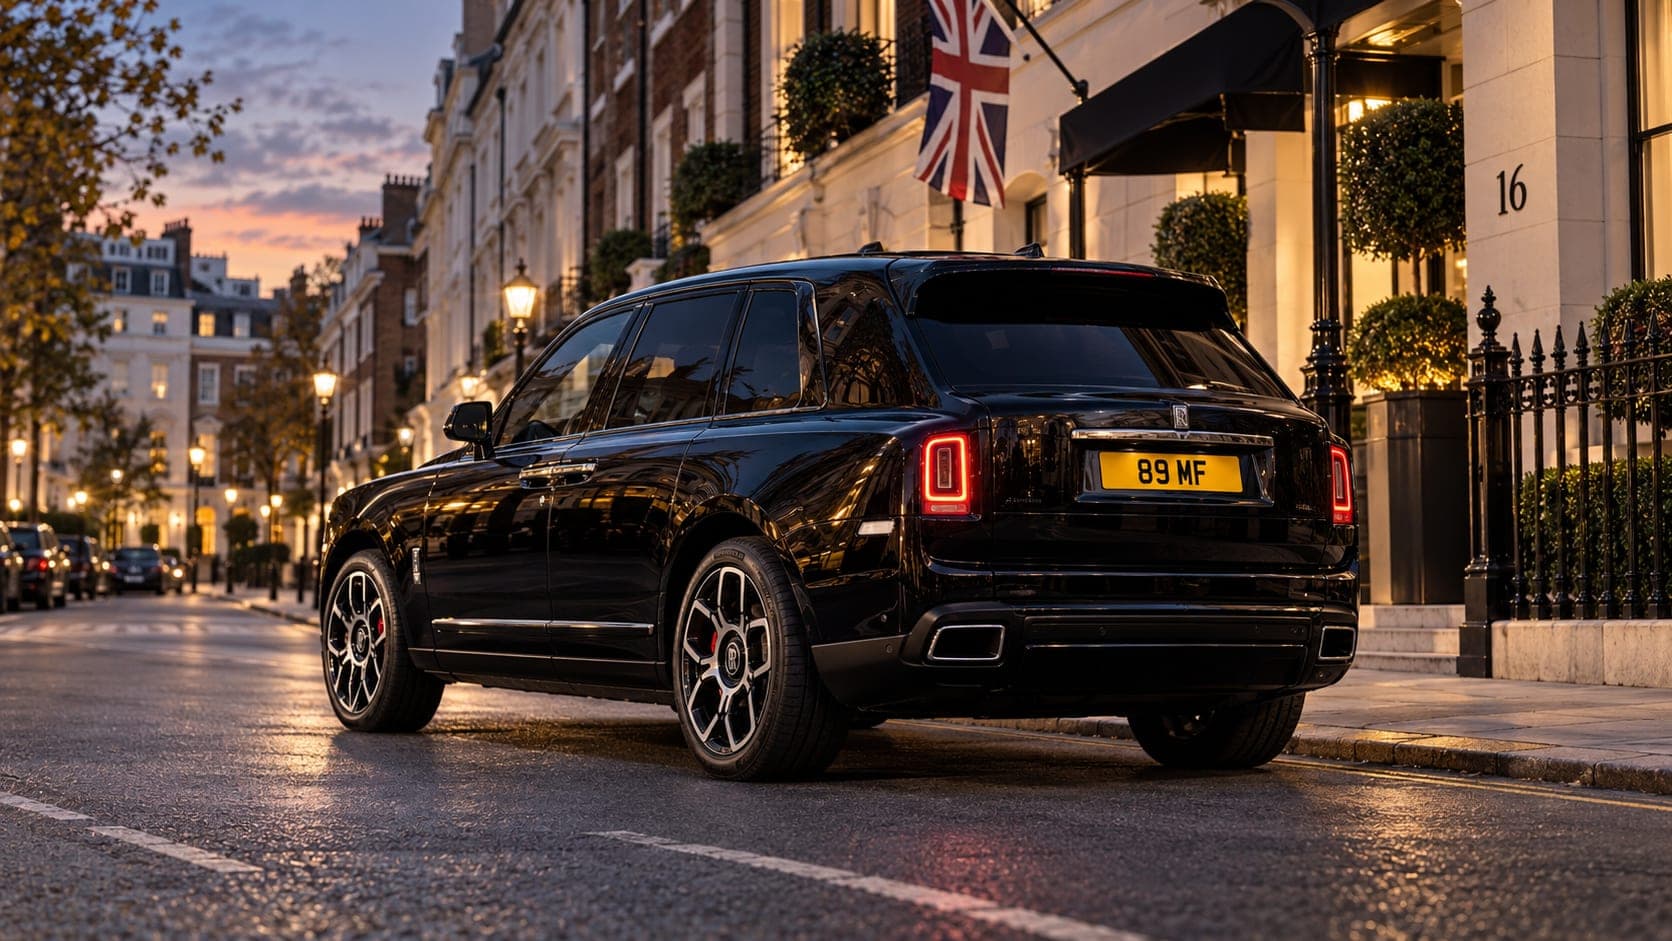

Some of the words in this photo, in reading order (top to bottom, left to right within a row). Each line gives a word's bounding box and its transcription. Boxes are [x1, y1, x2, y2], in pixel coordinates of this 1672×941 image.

[1496, 163, 1527, 216] 16
[1138, 459, 1169, 485] 89
[1177, 460, 1206, 486] MF
